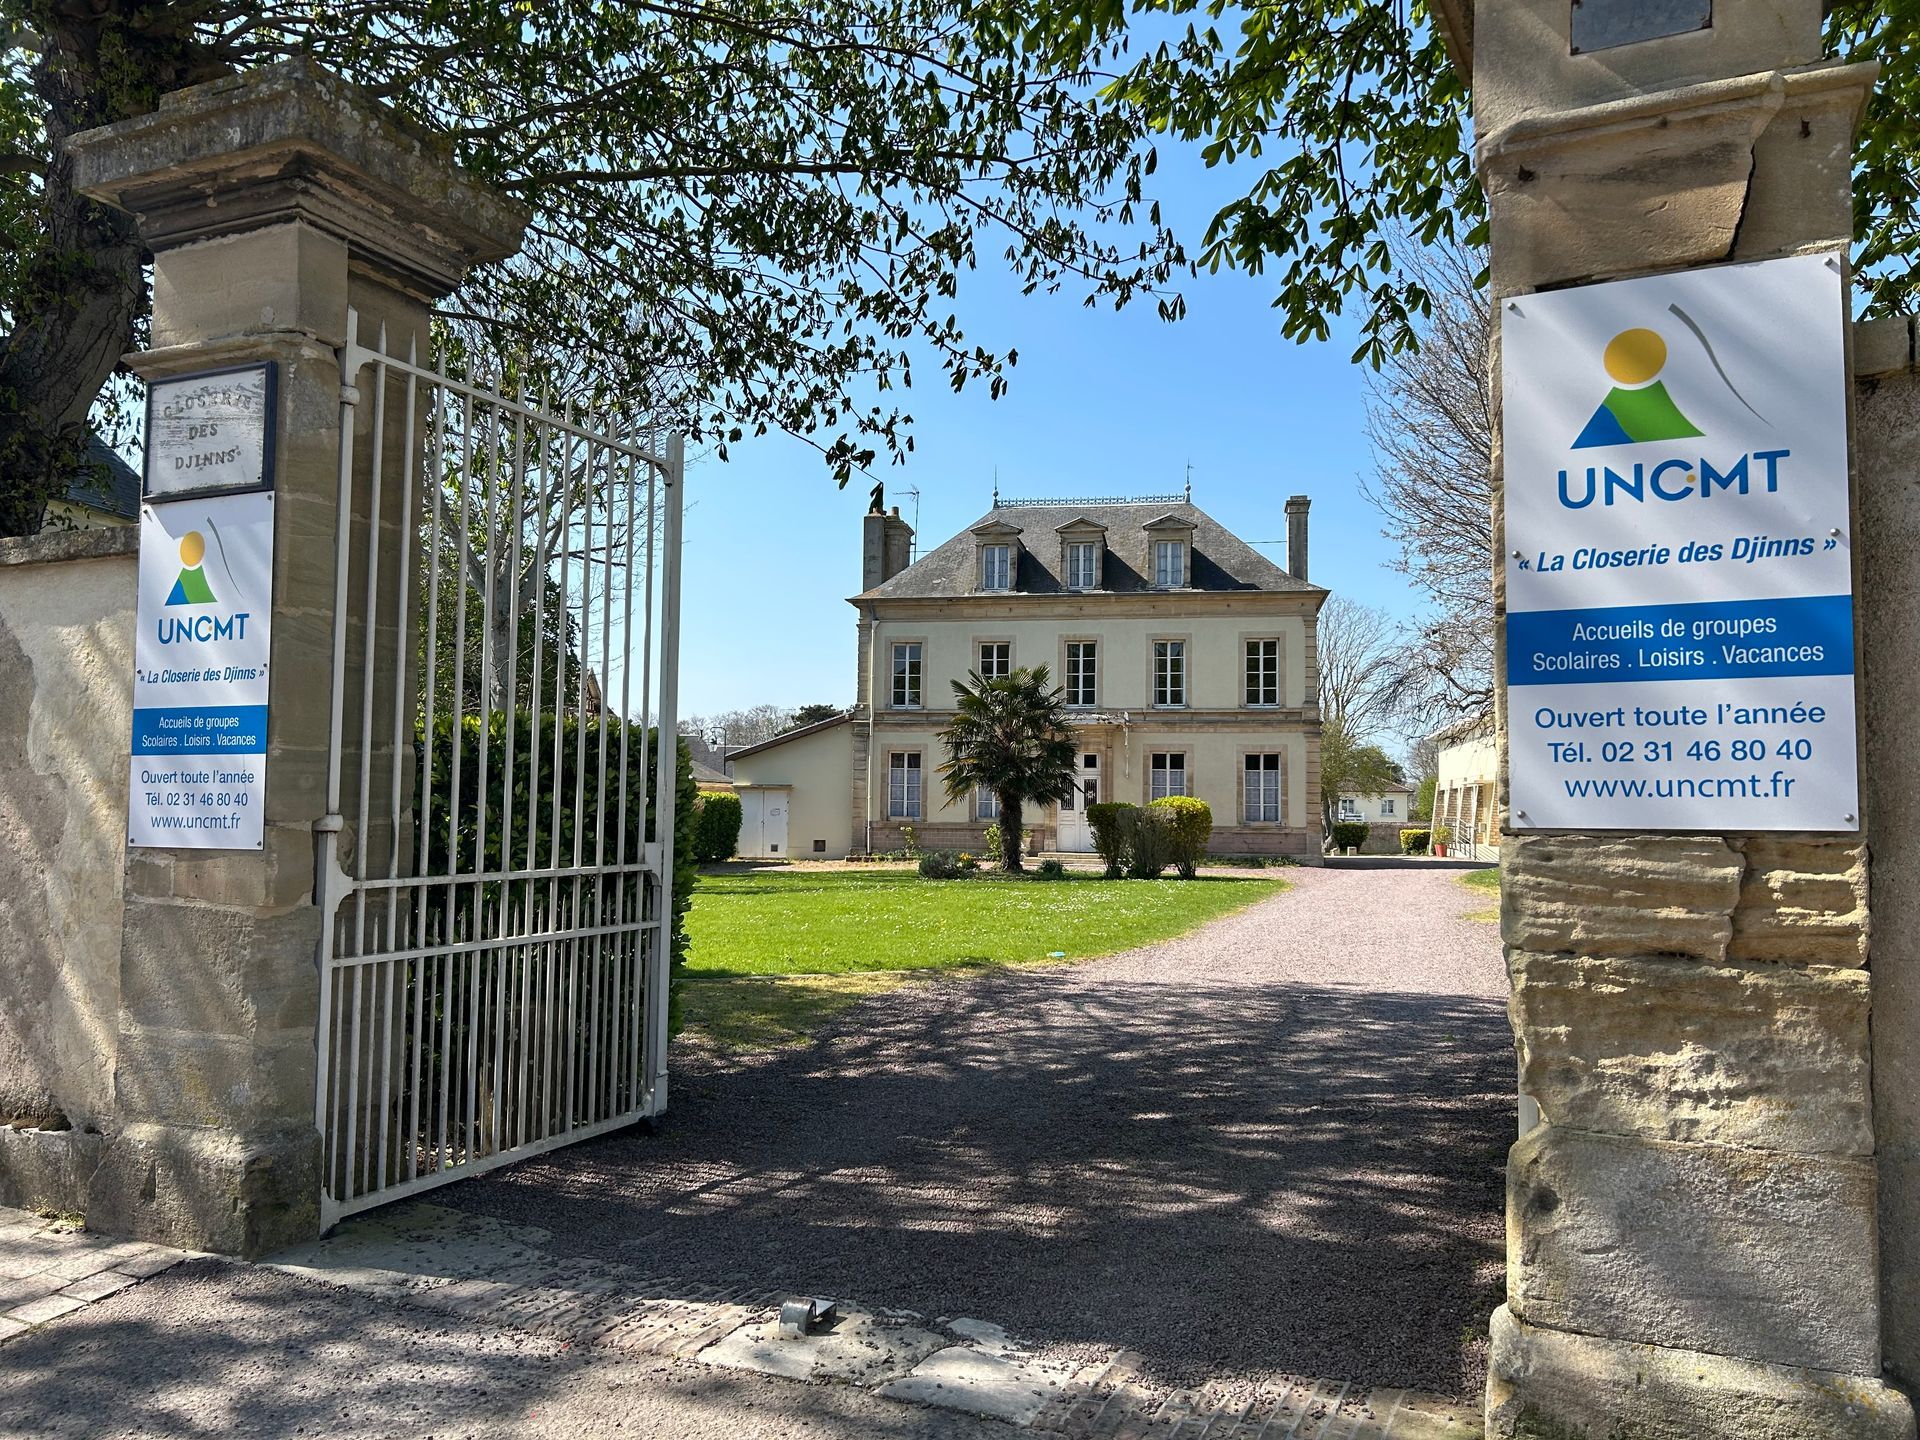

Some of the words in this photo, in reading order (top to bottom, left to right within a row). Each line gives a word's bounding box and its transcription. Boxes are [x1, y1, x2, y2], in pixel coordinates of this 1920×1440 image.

[188, 423, 218, 440] DES
[1558, 449, 1790, 510] UNCMT
[1537, 551, 1564, 573] La
[1572, 544, 1670, 569] Closerie
[1678, 541, 1723, 563] des
[1731, 535, 1815, 564] Djinns
[158, 613, 249, 644] UNCMT
[1572, 621, 1654, 642] Accueils
[1661, 619, 1685, 638] de
[1692, 616, 1777, 640] groupes
[1533, 652, 1621, 672] Scolaires
[1639, 647, 1705, 667] Loisirs
[1721, 644, 1825, 665] Vacances
[147, 670, 159, 683] La
[161, 669, 200, 683] Closerie
[203, 668, 221, 681] des
[224, 666, 256, 683] Djinns
[159, 716, 192, 729] Accueils
[193, 715, 204, 728] de
[206, 716, 239, 731] groupes
[1534, 706, 1626, 729] Ouvert
[1634, 705, 1708, 726] toute
[1717, 701, 1826, 725] l’année
[142, 734, 178, 747] Scolaires
[184, 734, 211, 746] Loisirs
[216, 733, 256, 746] Vacances
[1547, 740, 1592, 763] Tél.
[1601, 741, 1635, 763] 02
[1643, 740, 1673, 763] 31
[1686, 740, 1722, 762] 46
[1730, 739, 1767, 761] 80
[1776, 738, 1813, 761] 40
[141, 770, 178, 784] Ouvert
[180, 770, 209, 784] toute
[213, 769, 255, 784] l’année
[1564, 770, 1796, 798] www.uncmt.fr
[145, 792, 163, 806] Tél.
[166, 792, 180, 806] 02
[183, 792, 195, 806] 31
[200, 792, 214, 806] 46
[217, 792, 231, 806] 80
[233, 792, 248, 806] 40
[151, 812, 241, 829] www.uncmt.fr
